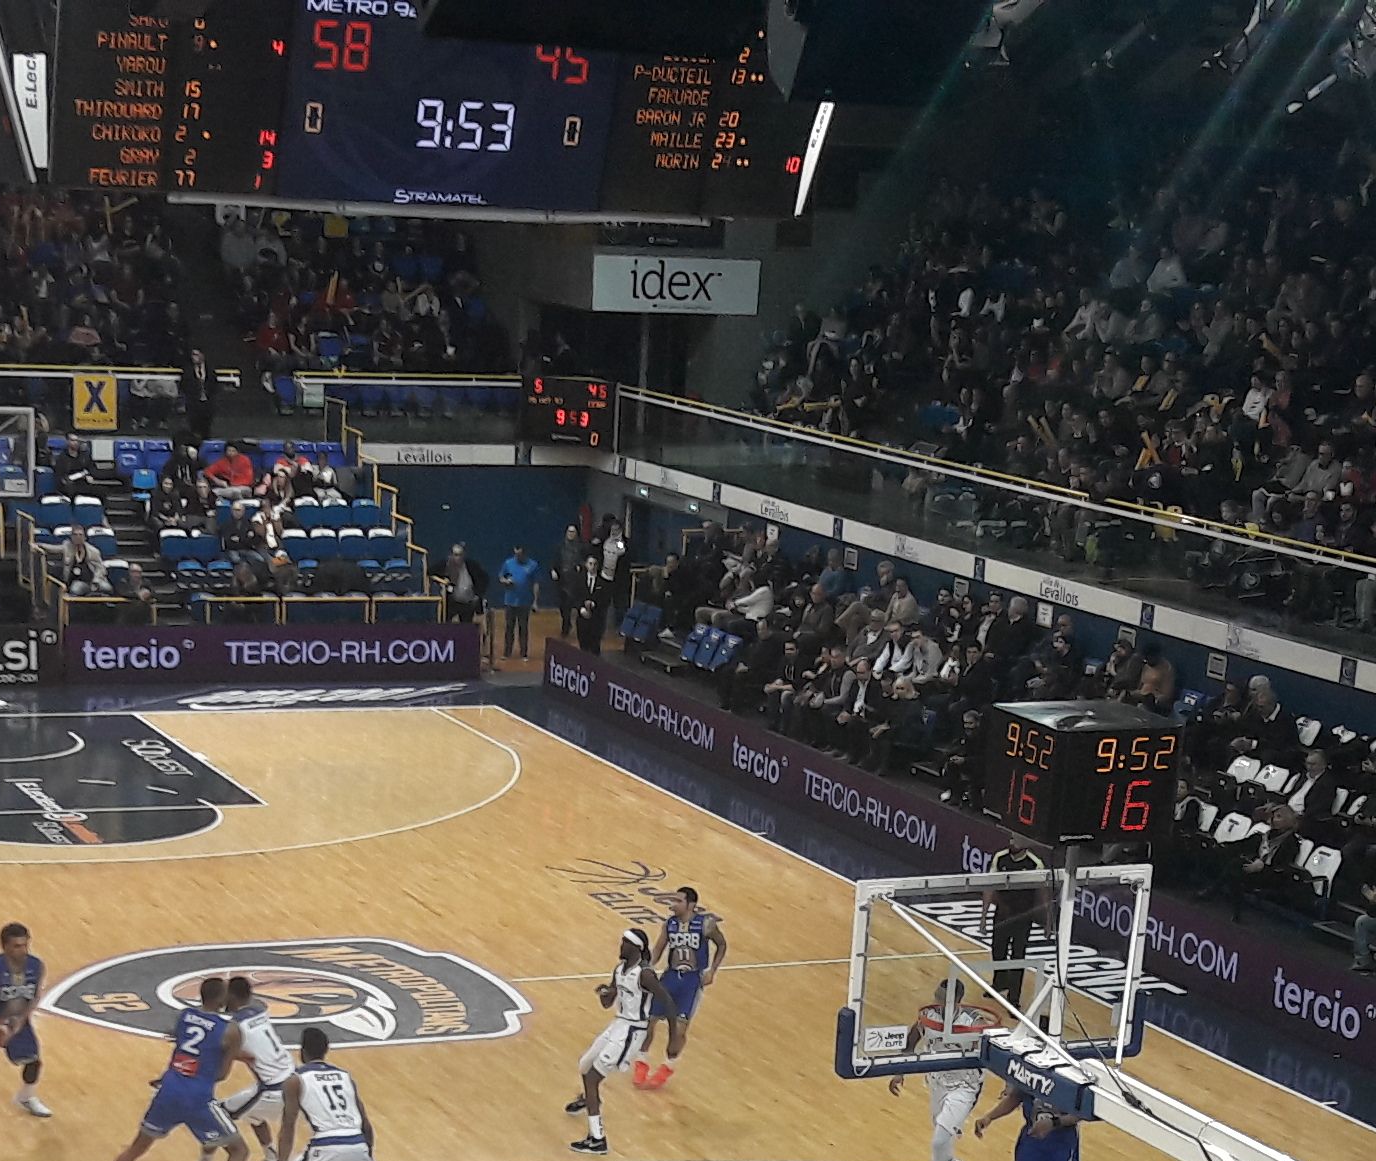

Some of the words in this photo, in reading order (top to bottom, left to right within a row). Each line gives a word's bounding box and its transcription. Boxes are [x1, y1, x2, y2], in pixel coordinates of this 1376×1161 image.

[307, 0, 388, 15] METRO
[271, 39, 286, 56] 4
[314, 19, 372, 71] 58
[535, 43, 590, 85] 45
[731, 69, 746, 85] 13
[114, 78, 165, 97] SMITH
[185, 80, 202, 98] 15
[183, 102, 201, 120] 17
[304, 101, 323, 133] 0
[416, 98, 517, 152] 9:53
[719, 111, 740, 128] 20
[175, 124, 187, 142] 2
[258, 130, 277, 147] 14
[563, 115, 581, 147] 0
[715, 132, 736, 149] 23
[261, 151, 275, 169] 3
[786, 157, 801, 173] 10
[175, 169, 197, 187] 77
[631, 259, 714, 301] idex
[84, 380, 108, 413] X
[397, 450, 454, 466] Levallois
[1040, 581, 1079, 607] Levallois
[82, 638, 181, 670] tercio
[225, 639, 455, 666] TERCIO-RH.COM
[548, 653, 590, 700] tercio
[606, 683, 715, 753] TERCIO-RH.COM
[731, 735, 782, 787] tercio
[1006, 722, 1056, 770] 9:52
[1096, 736, 1176, 773] 9:52
[801, 768, 938, 853] TERCIO-RH.COM
[1007, 770, 1040, 826] 16
[1099, 779, 1153, 832] 16
[1273, 966, 1362, 1040] tercio
[181, 1026, 206, 1056] 2
[323, 1084, 347, 1111] 15
